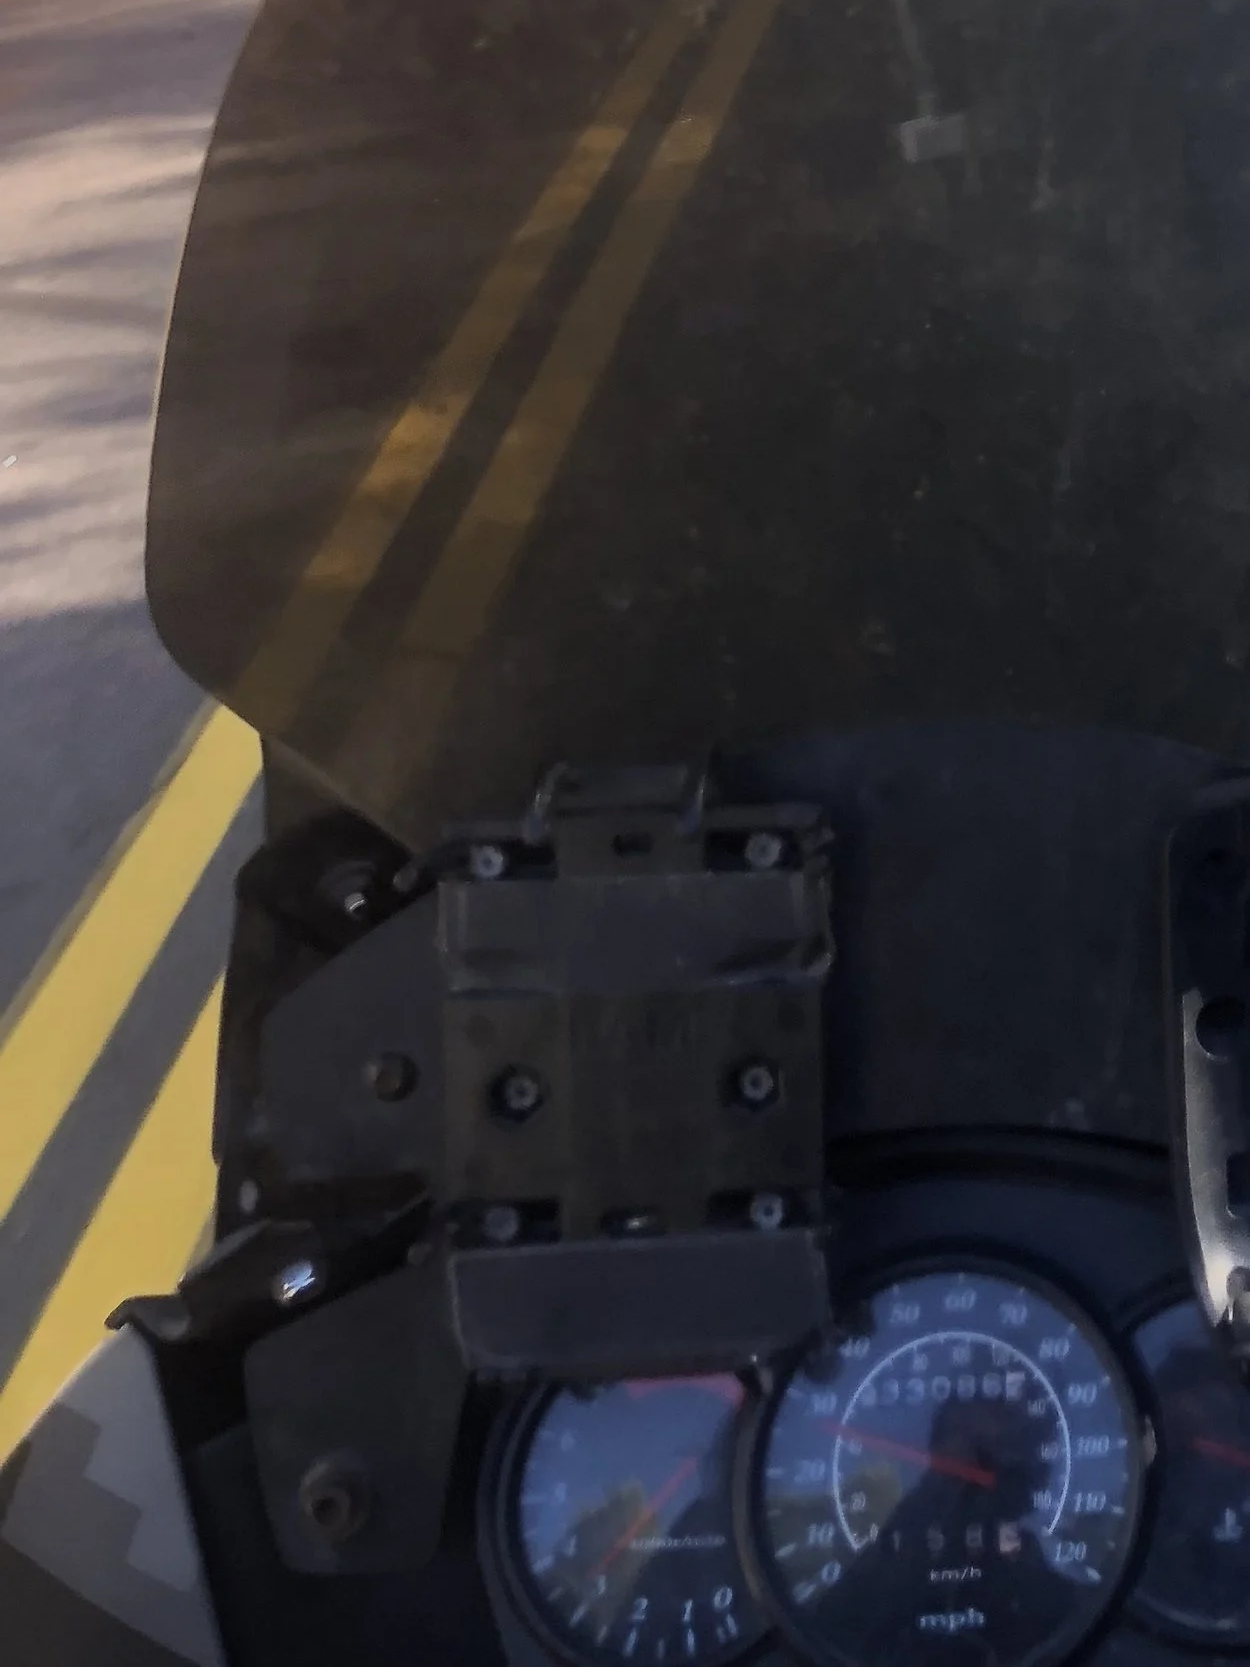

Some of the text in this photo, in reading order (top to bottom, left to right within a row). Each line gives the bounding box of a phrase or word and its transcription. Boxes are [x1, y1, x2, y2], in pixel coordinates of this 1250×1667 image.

[1067, 1382, 1099, 1405] 90
[1077, 1435, 1110, 1456] 100
[1073, 1491, 1106, 1512] 110
[1055, 1541, 1088, 1563] 120
[929, 1565, 983, 1583] km/h
[631, 1597, 649, 1622] 2
[713, 1586, 734, 1610] 0
[682, 1599, 694, 1623] 1
[919, 1605, 986, 1632] mph
